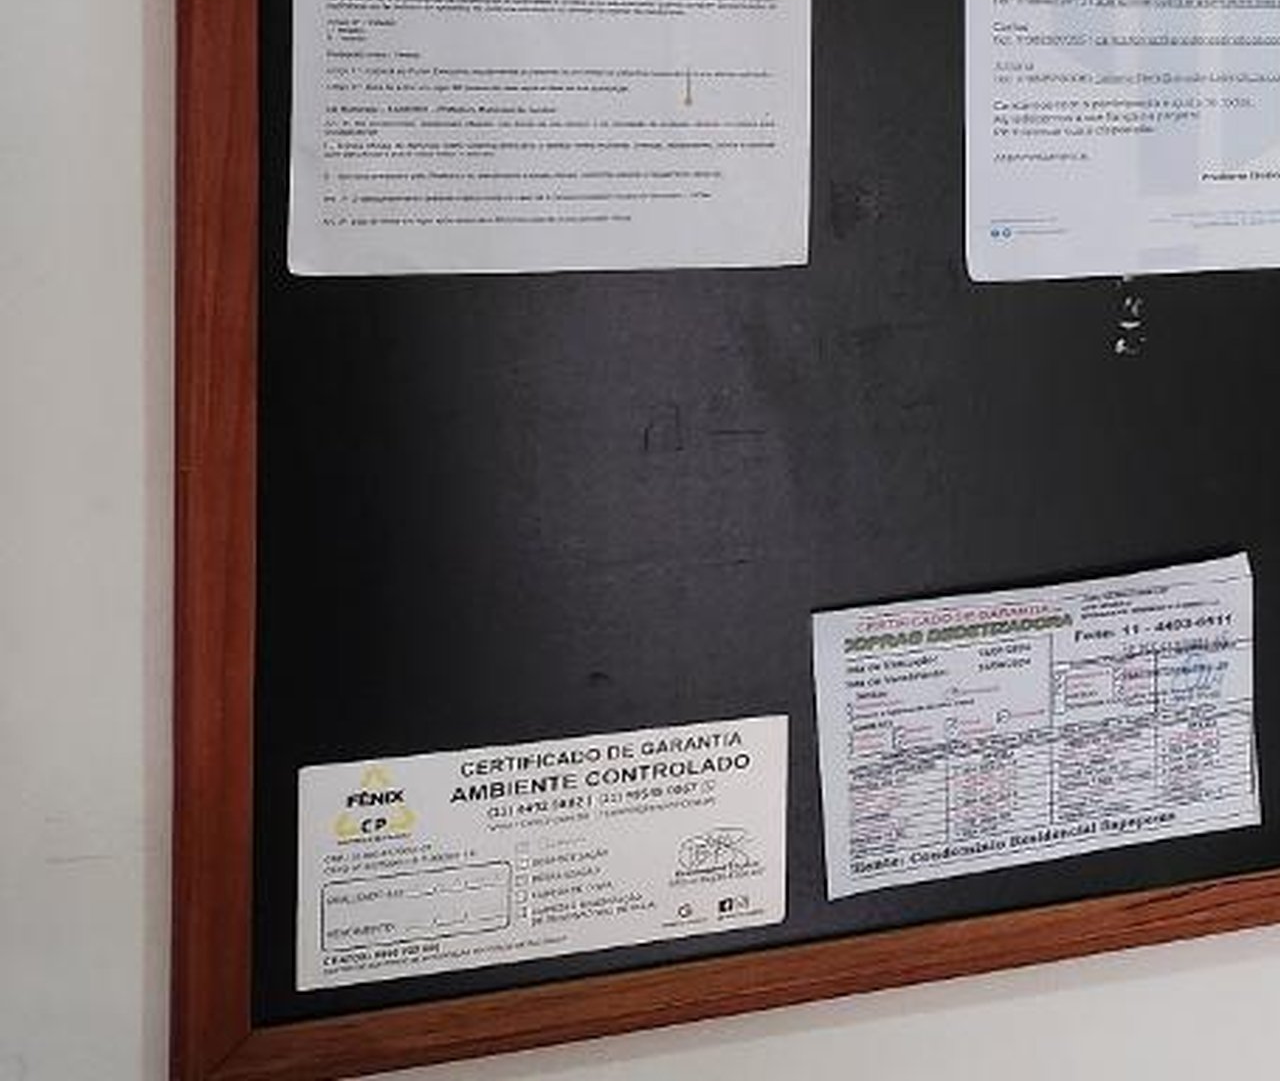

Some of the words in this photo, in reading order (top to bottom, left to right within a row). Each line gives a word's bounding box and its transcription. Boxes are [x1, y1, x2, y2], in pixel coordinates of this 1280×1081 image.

[450, 774, 579, 804] AMBIENTE
[584, 753, 751, 789] CONTROLADO
[460, 747, 601, 780] CERTIFICADO
[606, 742, 635, 762] DE
[640, 731, 743, 758] GARANTIA
[346, 789, 405, 809] FÊNIX
